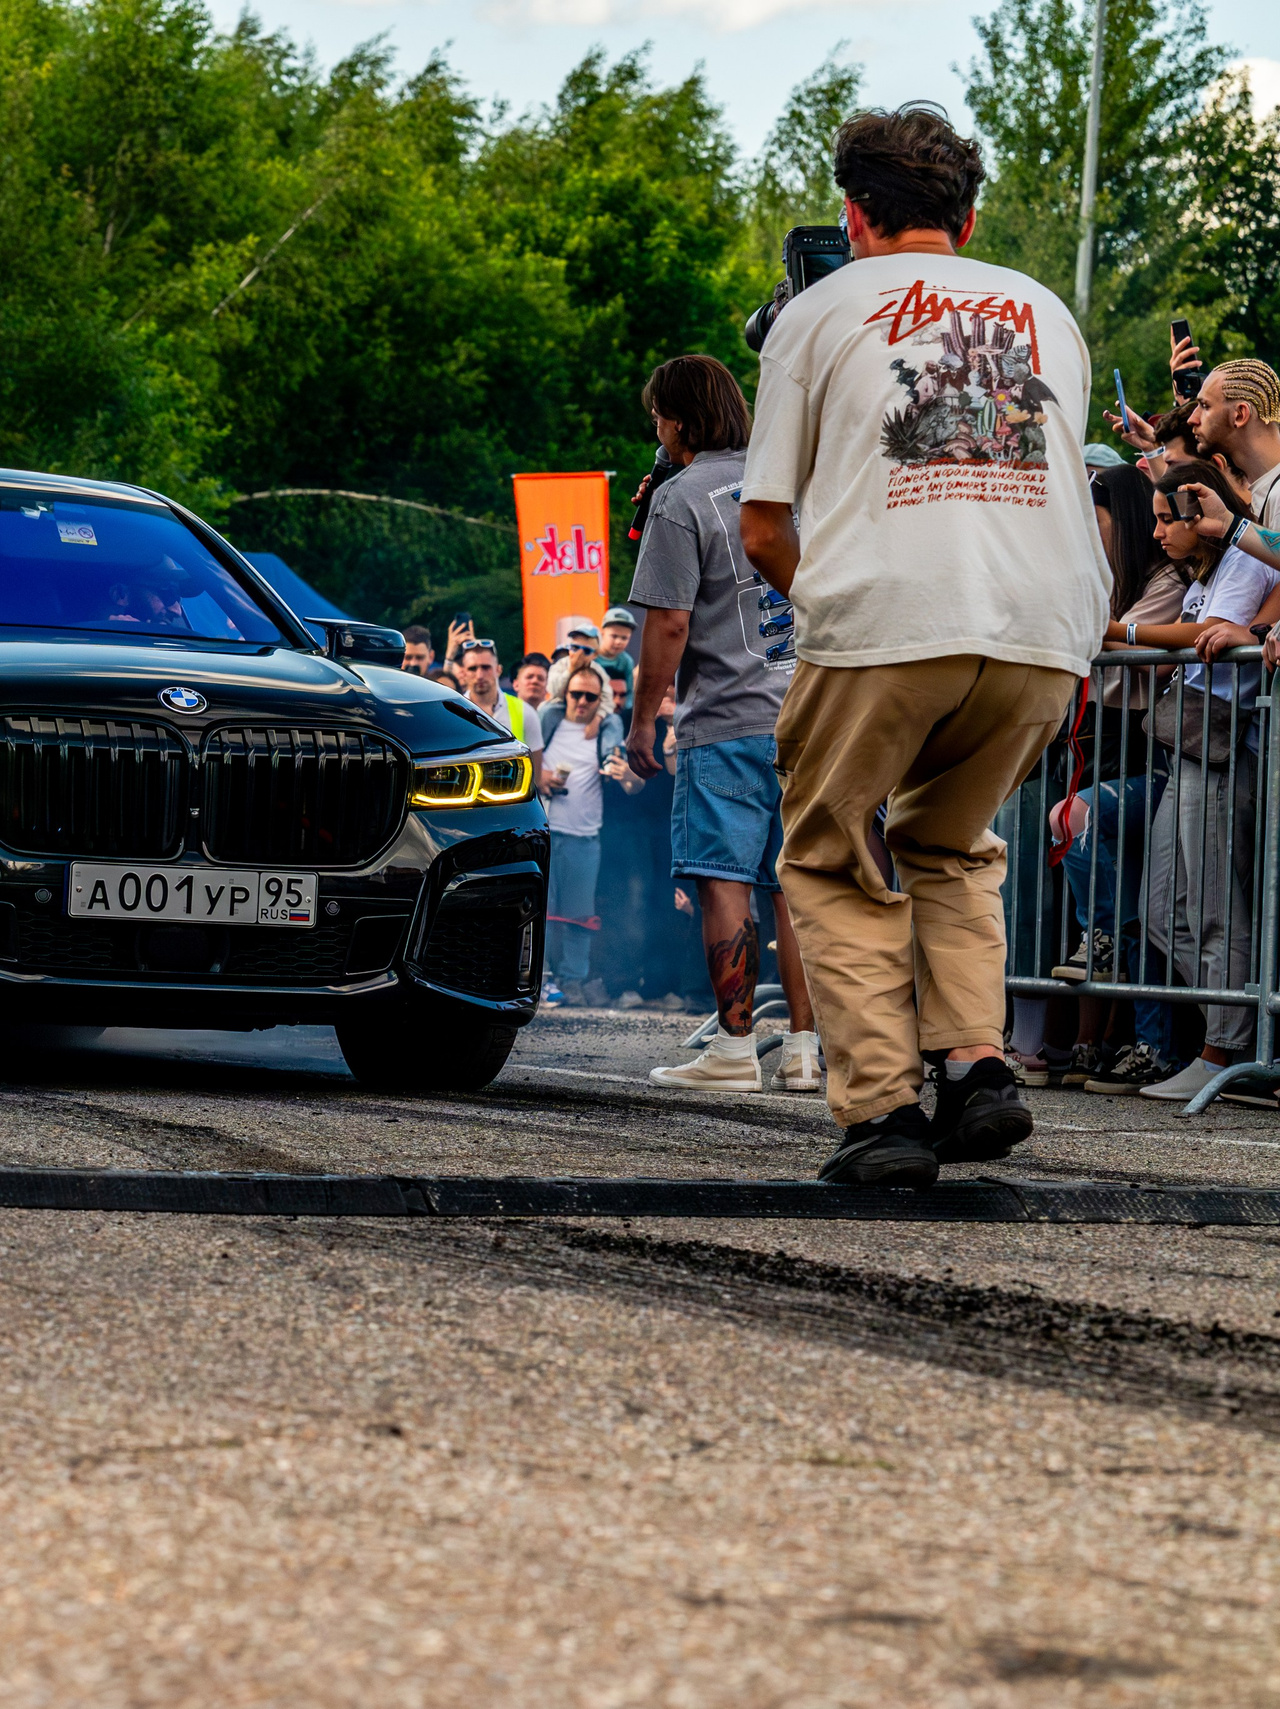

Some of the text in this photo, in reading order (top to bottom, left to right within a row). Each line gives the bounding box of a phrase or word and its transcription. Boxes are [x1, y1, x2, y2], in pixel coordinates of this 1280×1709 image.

[888, 471, 930, 488] FLOWERS
[1016, 471, 1046, 483] COULD
[927, 481, 946, 492] ANY
[991, 483, 1021, 494] STORY
[1023, 484, 1049, 495] TELL
[1026, 497, 1047, 508] ROSE
[264, 876, 304, 908] 95
[260, 908, 288, 920] RUS
